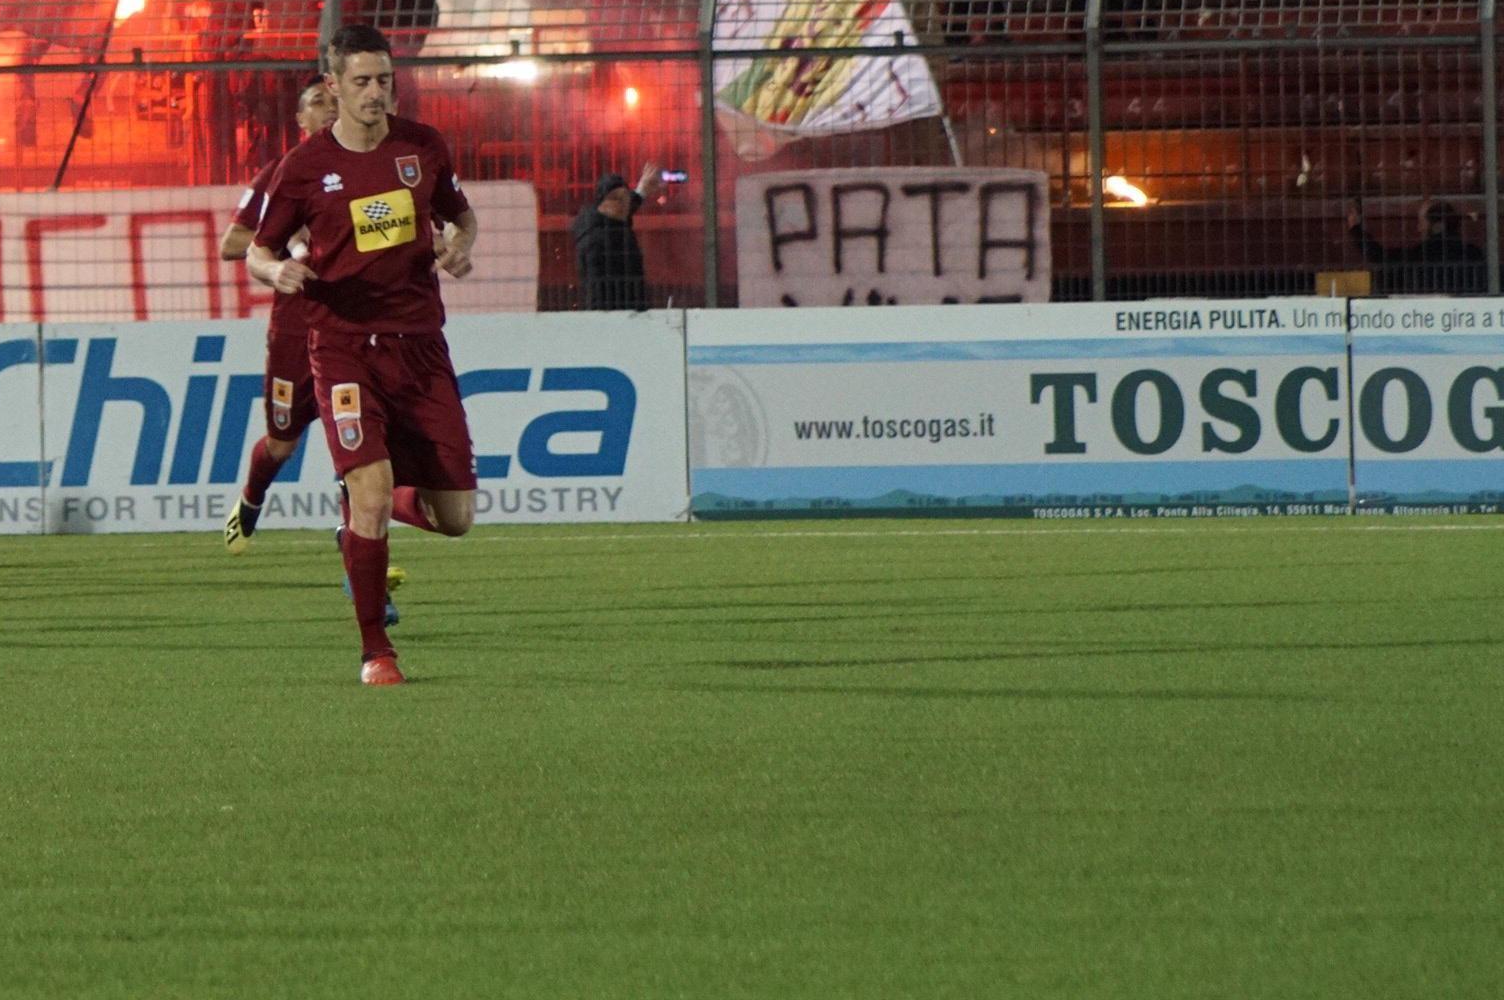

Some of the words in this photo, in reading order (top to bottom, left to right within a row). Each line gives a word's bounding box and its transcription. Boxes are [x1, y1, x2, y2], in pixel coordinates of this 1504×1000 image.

[359, 217, 413, 235] BARDAHL
[764, 181, 1038, 280] PATA
[1115, 310, 1203, 331] ENERGIA
[1209, 308, 1287, 330] PULITA.
[1292, 308, 1318, 329] Un
[1325, 307, 1395, 329] mondo
[1401, 308, 1435, 329] che
[1440, 308, 1475, 333] gira
[1481, 311, 1493, 329] a
[1029, 365, 1504, 456] TOSCOG
[793, 413, 996, 443] www.toscogas.it
[62, 495, 136, 524] FOR
[153, 493, 225, 519] THE
[1032, 507, 1091, 519] TOSCOGAS
